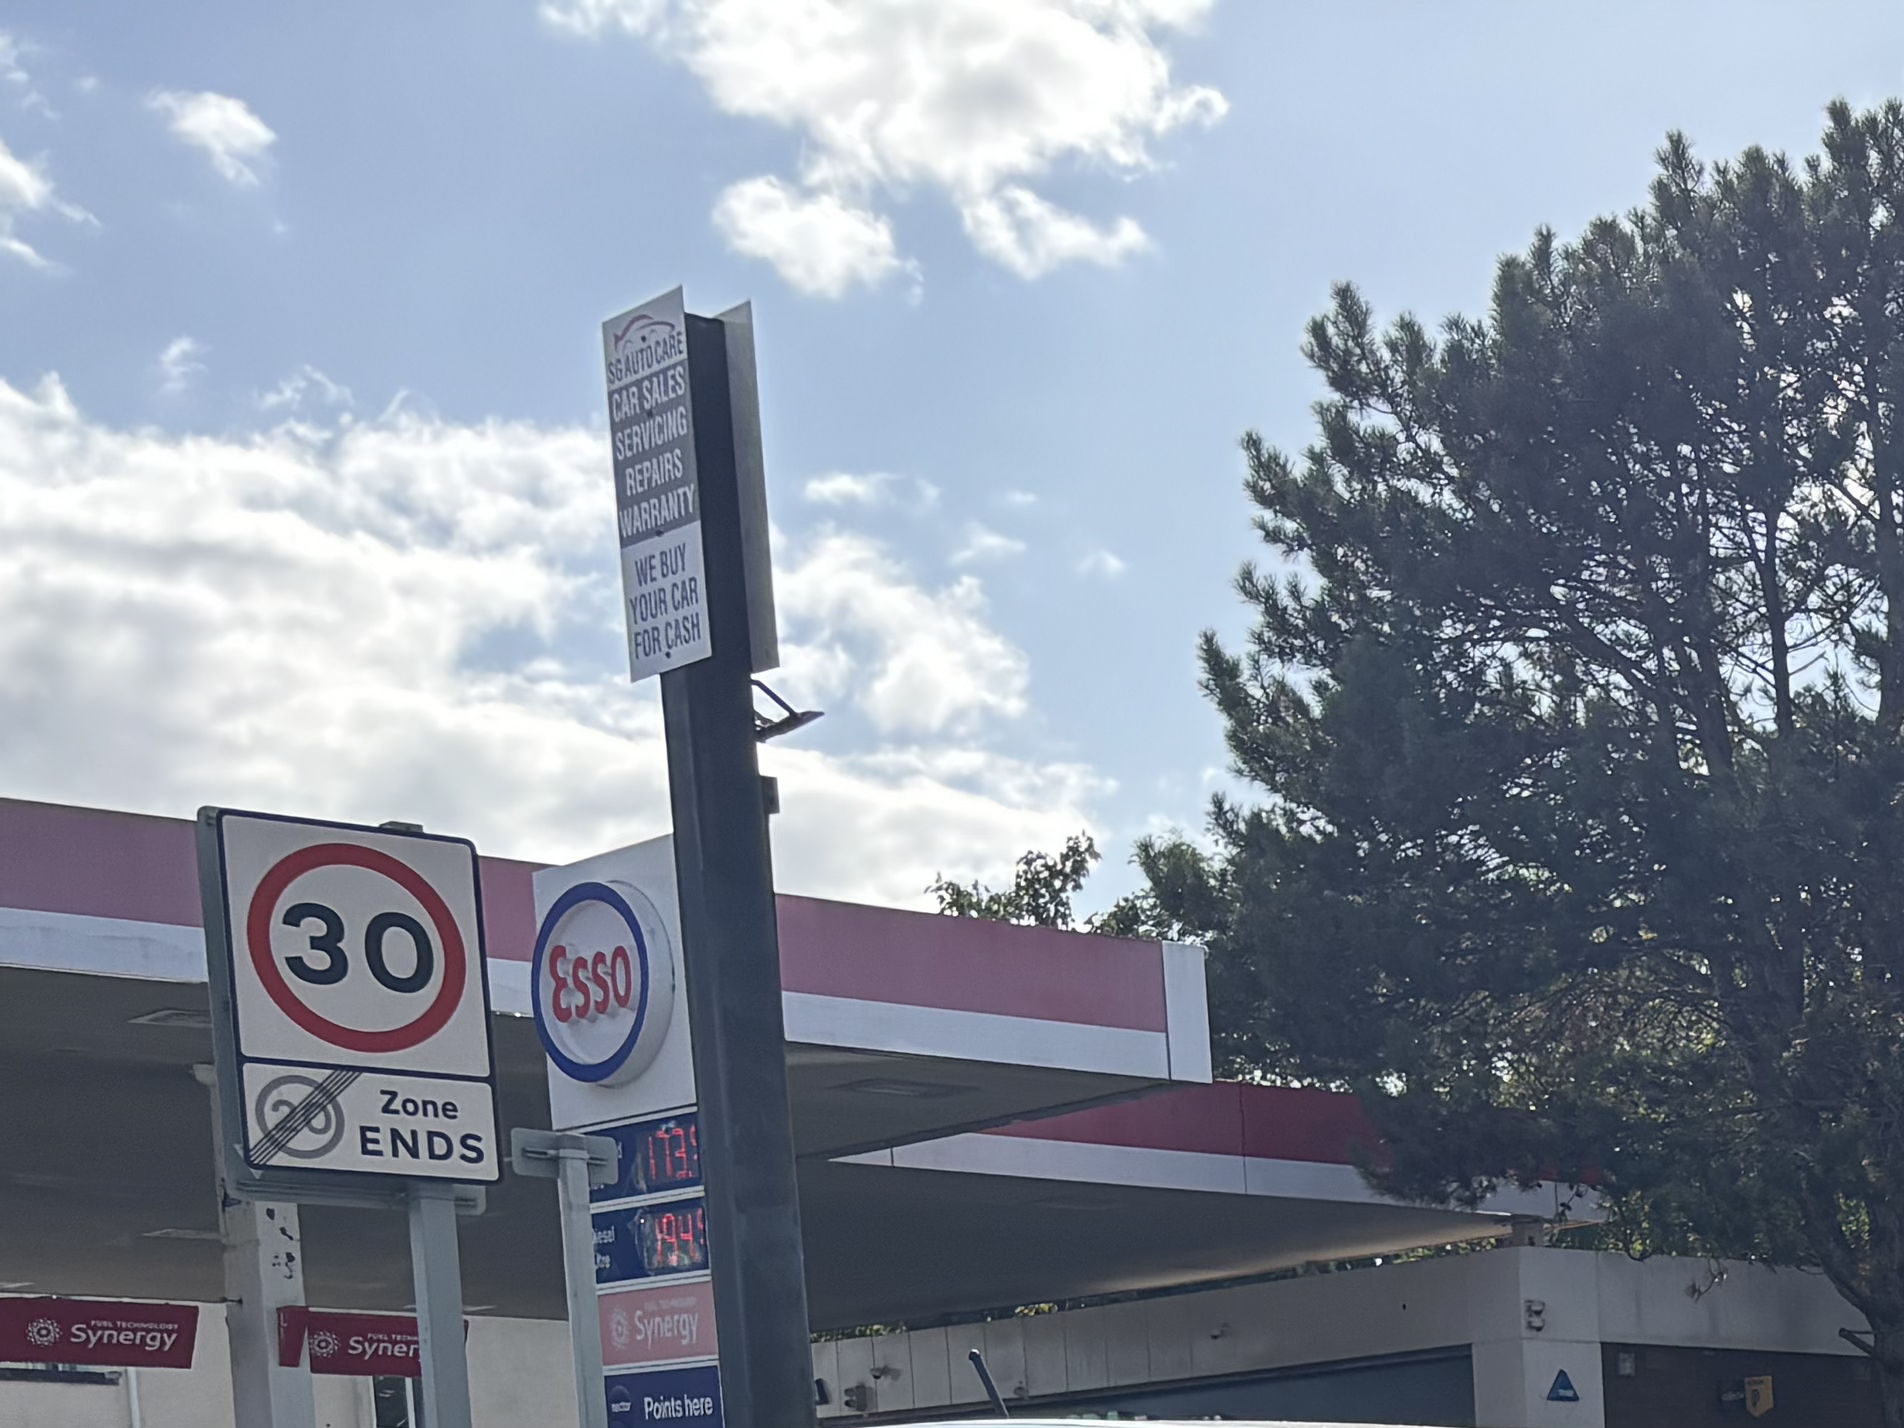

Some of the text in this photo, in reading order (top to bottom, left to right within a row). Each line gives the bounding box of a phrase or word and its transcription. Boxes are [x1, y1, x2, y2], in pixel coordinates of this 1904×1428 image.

[607, 331, 684, 384] SG AUTO CARE
[612, 370, 686, 422] CAR SALES
[615, 408, 688, 461] SERVICING
[625, 449, 684, 496] REPAIRS
[619, 483, 695, 539] WARRANTY
[635, 543, 687, 588] WE BUY
[629, 576, 699, 626] YOUR CAR
[634, 613, 702, 660] FOR CASH
[281, 902, 435, 993] 30
[380, 1089, 460, 1121] Zone
[360, 1126, 486, 1166] ENDS
[593, 1225, 615, 1245] iesel
[70, 1324, 178, 1351] Synergy
[347, 1336, 420, 1359] Syner
[634, 1309, 698, 1349] Synergy
[644, 1394, 714, 1420] Points here
